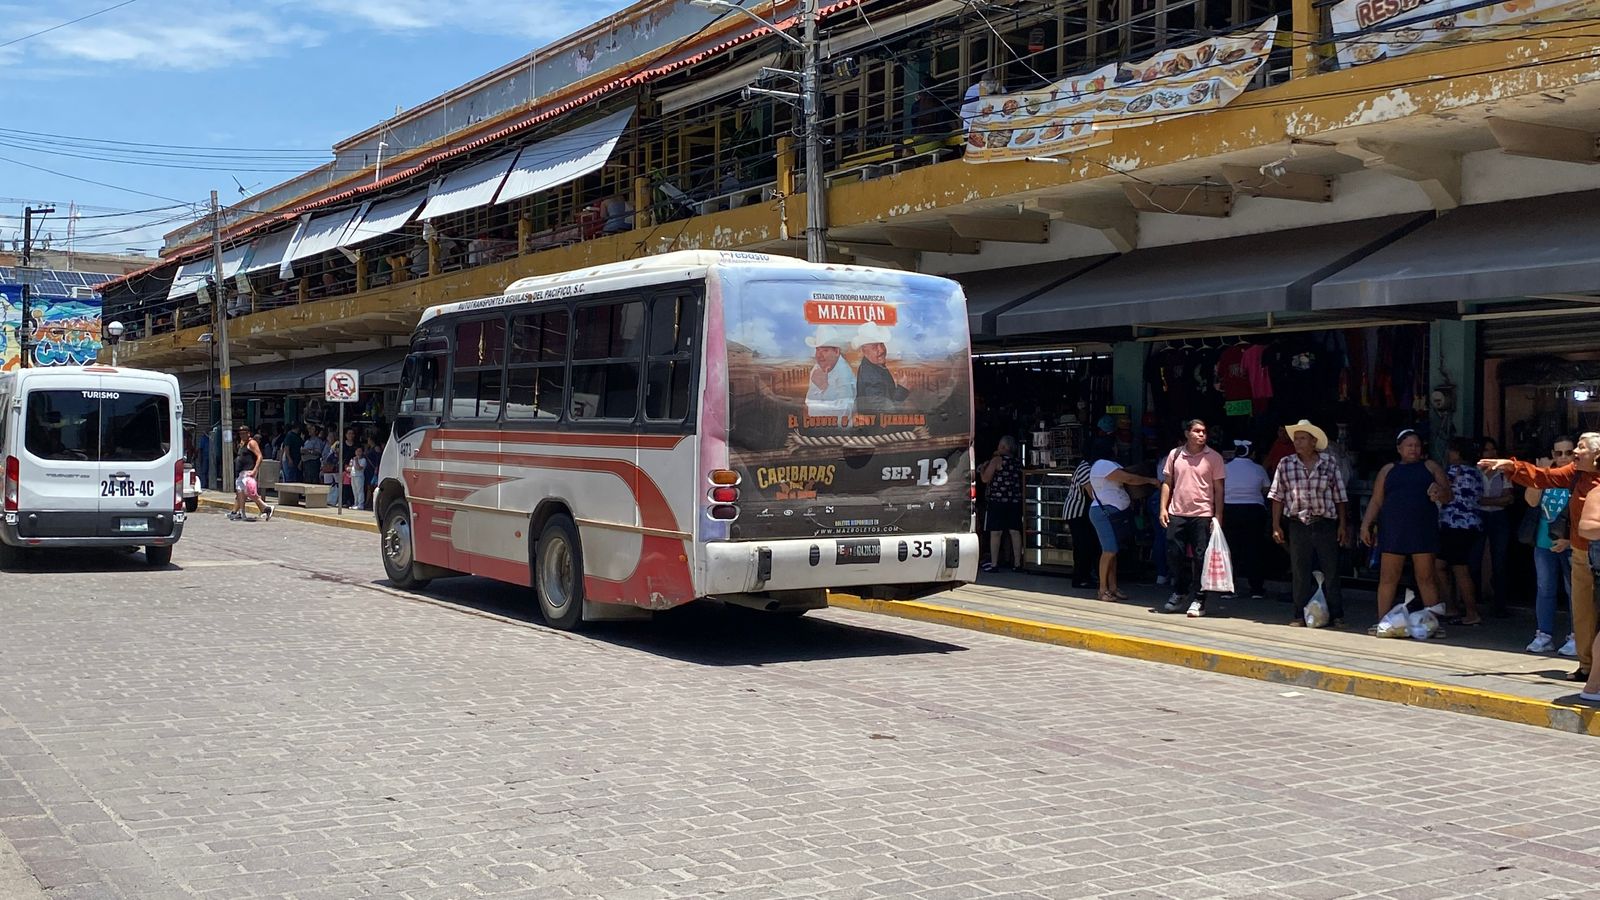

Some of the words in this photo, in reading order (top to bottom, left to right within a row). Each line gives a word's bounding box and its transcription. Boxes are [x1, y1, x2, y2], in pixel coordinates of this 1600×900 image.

[458, 296, 505, 311] AUTOTRANSPORTES
[505, 293, 528, 304] AGUILAS
[533, 291, 543, 302] DEL
[573, 283, 585, 294] S.C.
[818, 304, 886, 321] MAZATLÁN
[82, 391, 119, 399] TURISMO
[788, 414, 798, 428] EL
[757, 465, 836, 489] CAPIBARAS
[881, 466, 914, 480] SEP.
[916, 458, 948, 486] 13
[101, 480, 154, 497] 24-RB-4C
[912, 540, 932, 558] 35
